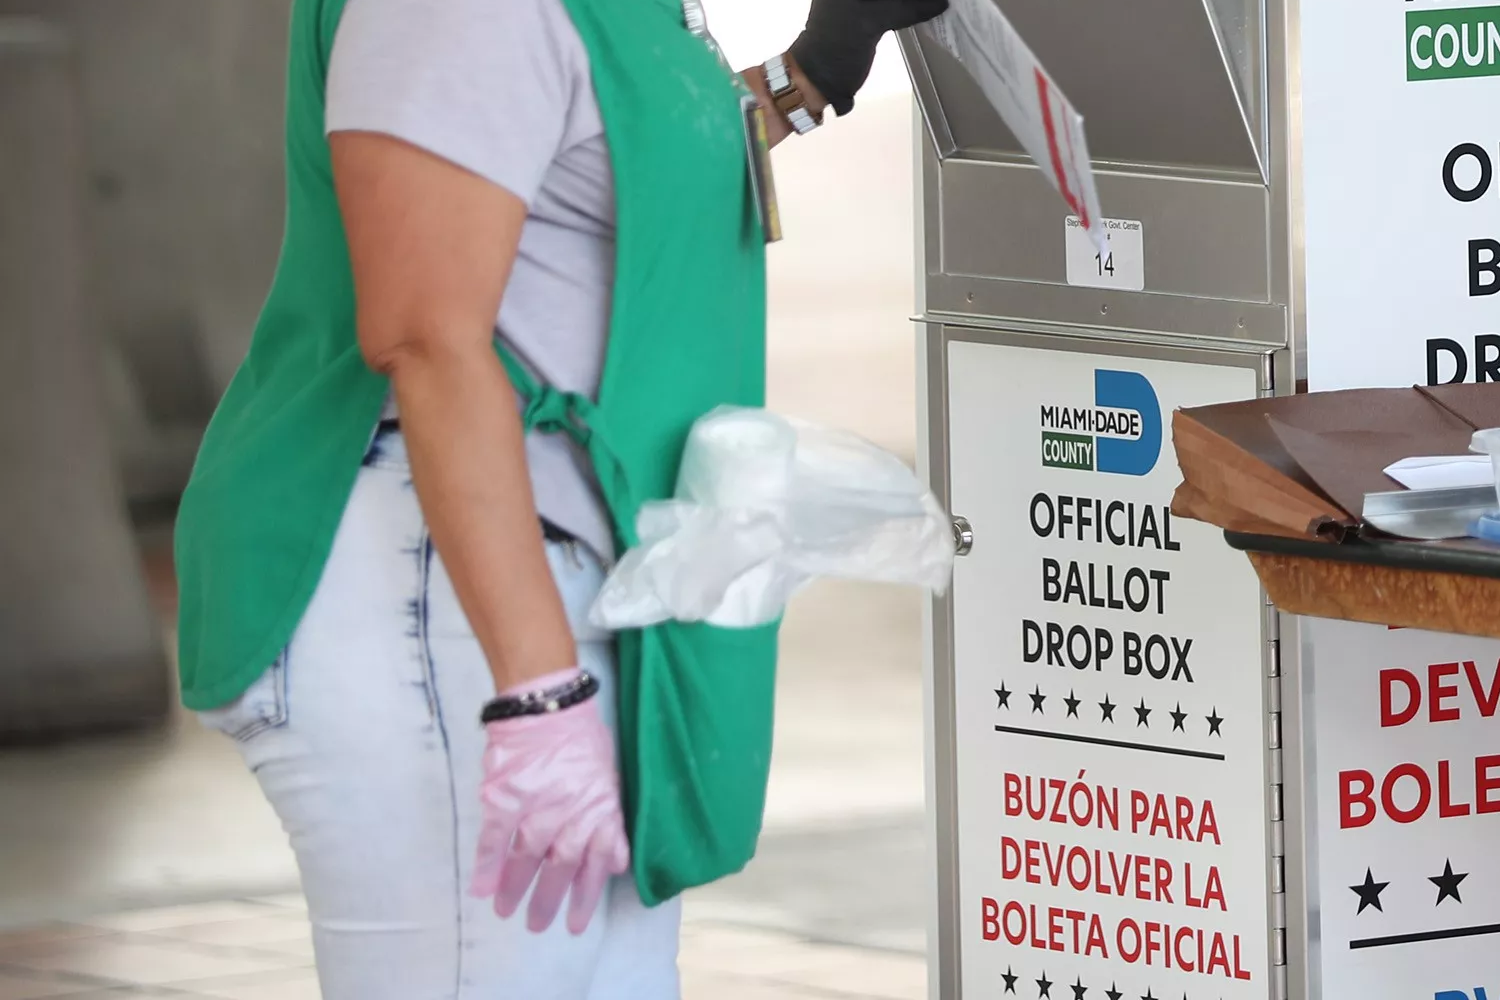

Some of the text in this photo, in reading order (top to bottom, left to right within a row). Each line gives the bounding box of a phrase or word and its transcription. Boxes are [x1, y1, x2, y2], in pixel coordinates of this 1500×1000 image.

[1122, 222, 1140, 231] Center
[1095, 251, 1114, 277] 14
[1043, 439, 1092, 465] COUNTY
[1029, 492, 1181, 551] OFFICIAL
[1042, 558, 1170, 614] BALLOT
[1022, 619, 1194, 683] DROP BOX
[1004, 769, 1221, 845] BUZÓN PARA
[1001, 836, 1228, 912] DEVOLVER LA
[981, 897, 1251, 981] BOLETA OFICIAL
